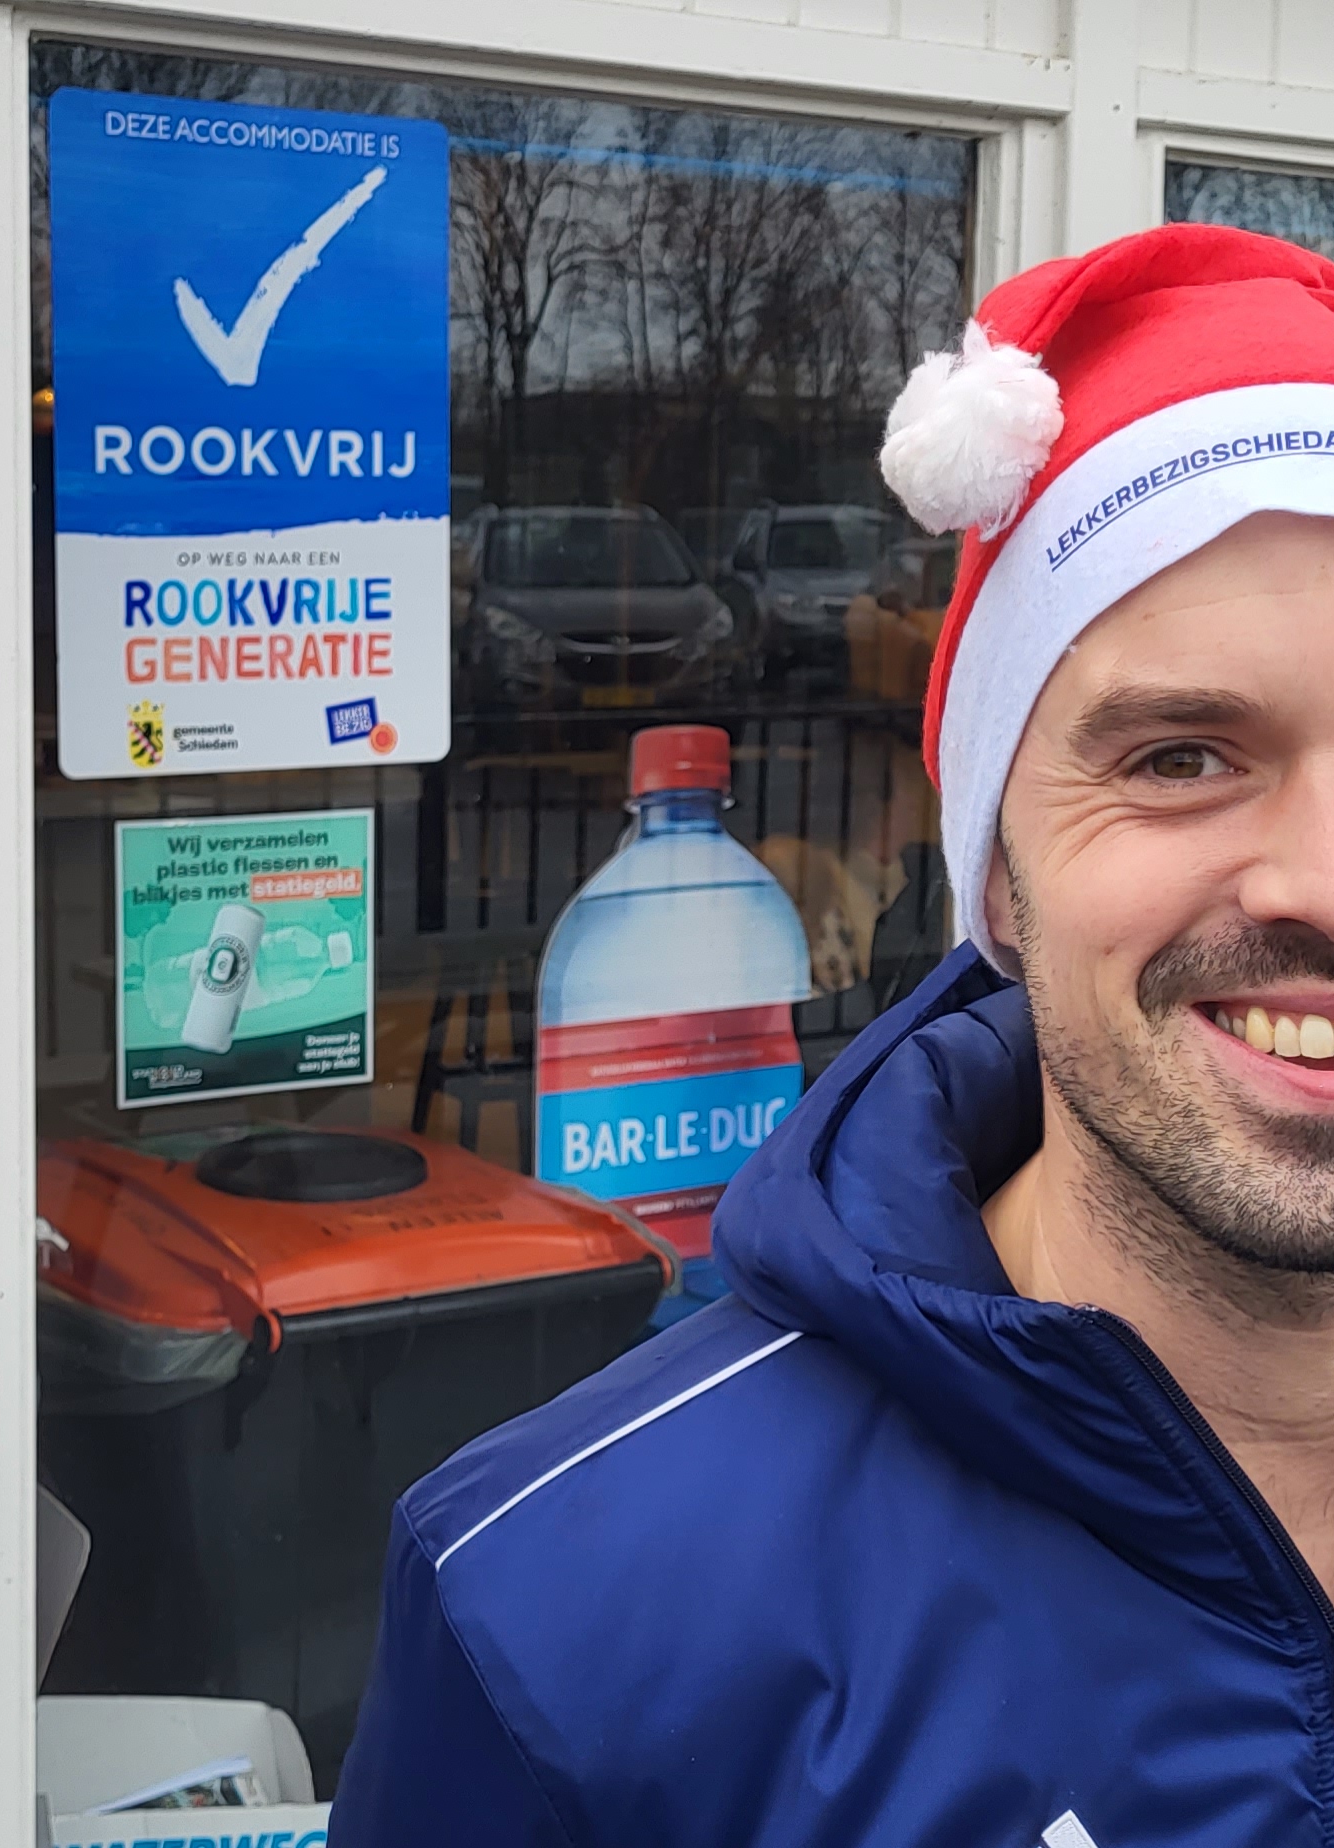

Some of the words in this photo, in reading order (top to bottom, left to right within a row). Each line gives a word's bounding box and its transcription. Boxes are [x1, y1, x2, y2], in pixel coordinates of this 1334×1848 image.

[105, 110, 171, 140] DEZE
[174, 118, 376, 158] ACCOMMODATIE
[380, 135, 400, 159] IS
[94, 425, 416, 478] ROOKVRIJ
[177, 551, 201, 567] OP
[208, 551, 247, 566] WEG
[254, 551, 302, 566] NAAR
[307, 551, 341, 566] EEN
[124, 577, 392, 628] ROOKVRIJE
[124, 632, 393, 684] GENERATIE
[173, 724, 234, 739] gemeente
[177, 738, 239, 752] Schiedam
[168, 835, 202, 857] Wij
[207, 829, 329, 851] verzamelen
[157, 859, 228, 882] plastic
[234, 856, 309, 875] flessen
[314, 854, 338, 869] en
[132, 885, 203, 906] blikjes
[207, 884, 249, 900] met
[253, 875, 360, 898] statiegeld.
